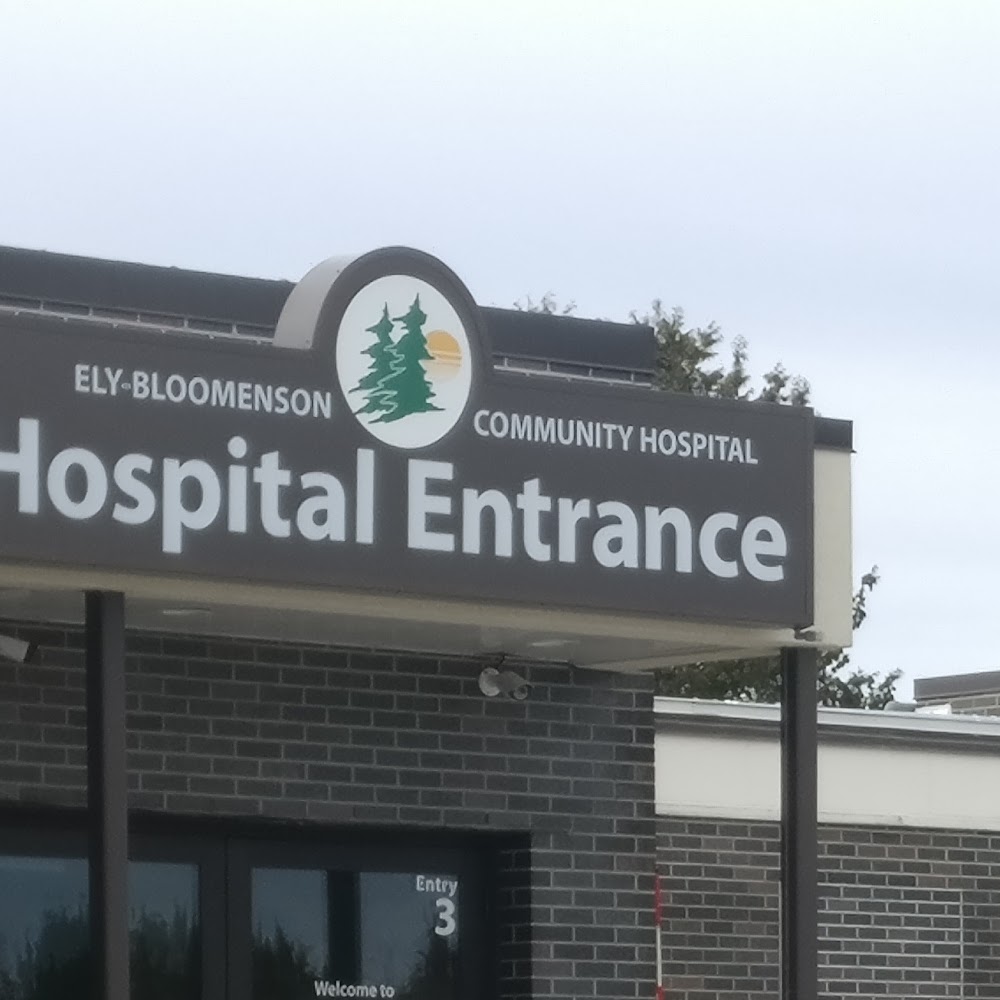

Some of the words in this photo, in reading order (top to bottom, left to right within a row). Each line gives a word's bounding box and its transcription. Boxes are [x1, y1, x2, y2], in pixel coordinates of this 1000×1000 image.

[74, 363, 333, 419] ELY-BLOOMENSON
[473, 408, 634, 452] COMMUNITY
[639, 426, 759, 465] HOSPITAL
[0, 417, 375, 554] Hospital
[407, 459, 788, 583] Entrance
[416, 874, 458, 897] Entry
[434, 897, 456, 936] 3
[314, 980, 378, 998] Welcome
[379, 984, 395, 998] to
